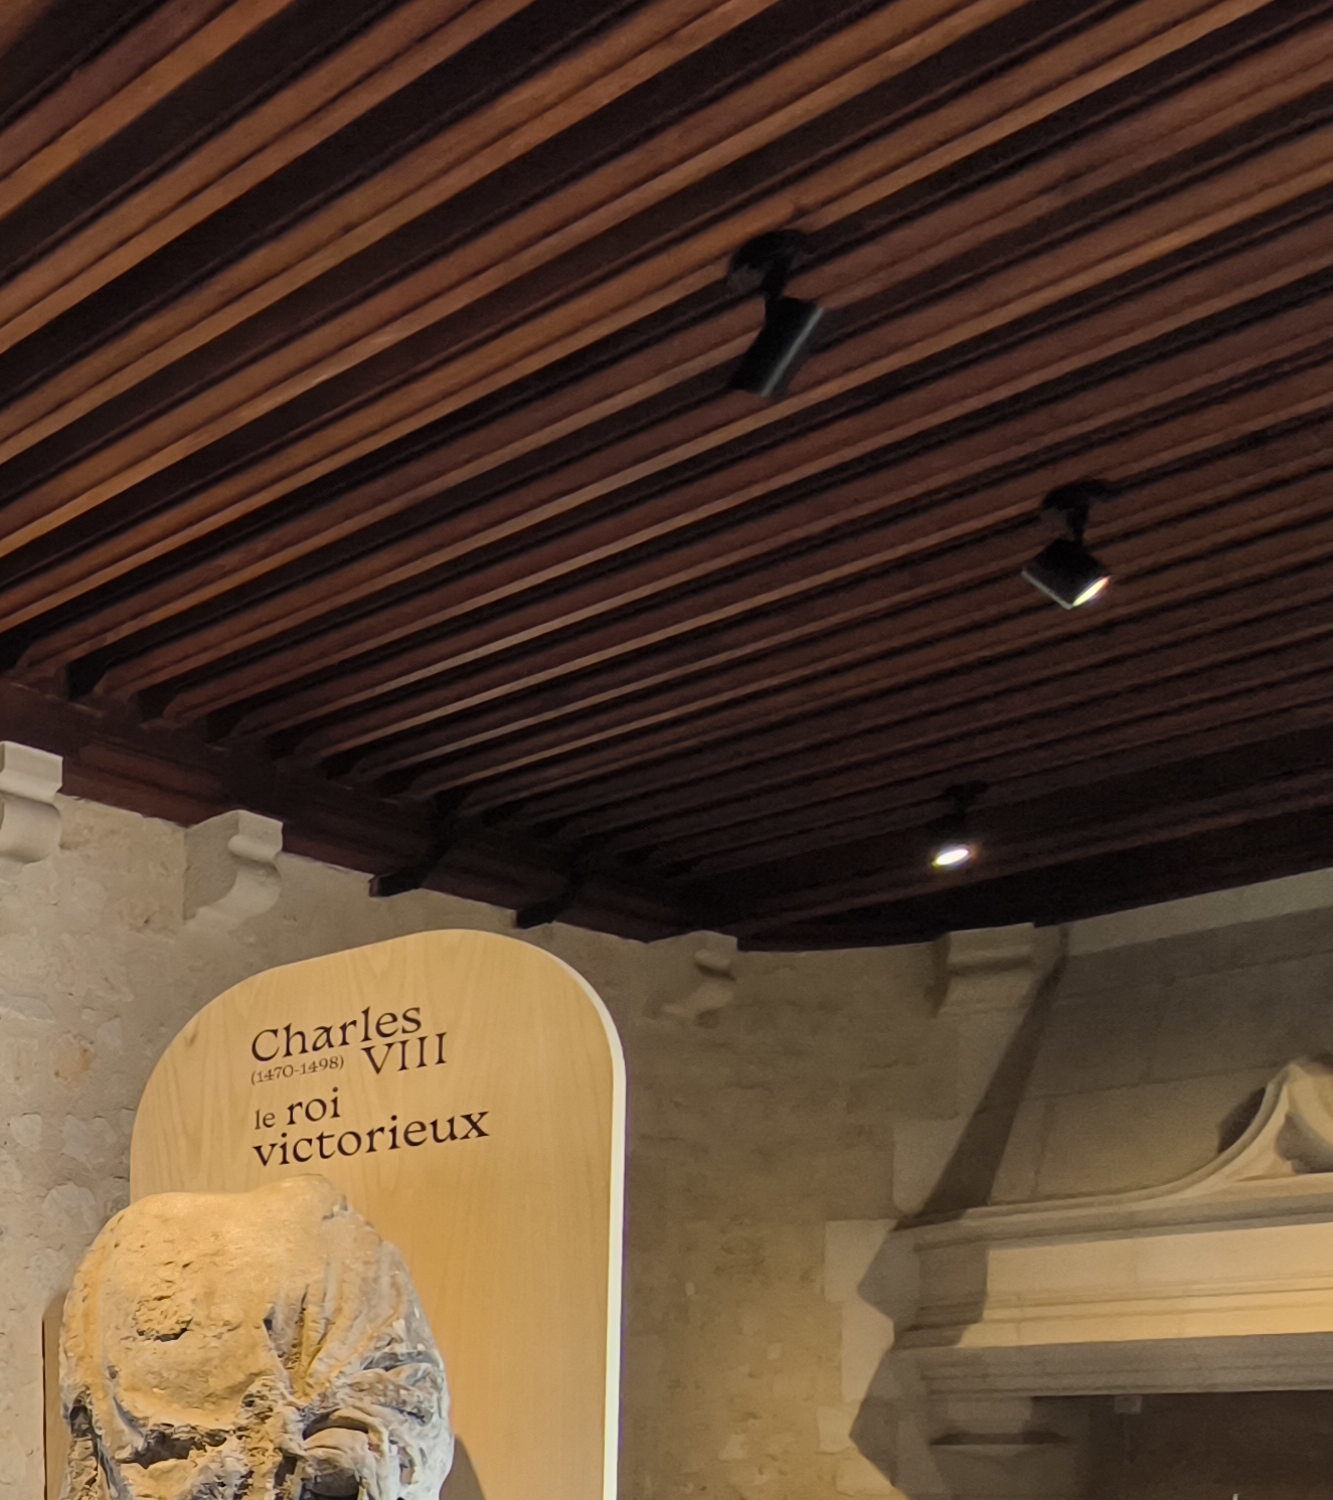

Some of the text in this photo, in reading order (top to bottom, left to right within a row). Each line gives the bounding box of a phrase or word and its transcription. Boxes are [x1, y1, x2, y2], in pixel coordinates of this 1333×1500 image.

[250, 1006, 423, 1062] Charles
[250, 1031, 448, 1086] (1470-1498) VIII
[254, 1087, 341, 1130] le roi
[252, 1111, 490, 1167] victorieux
